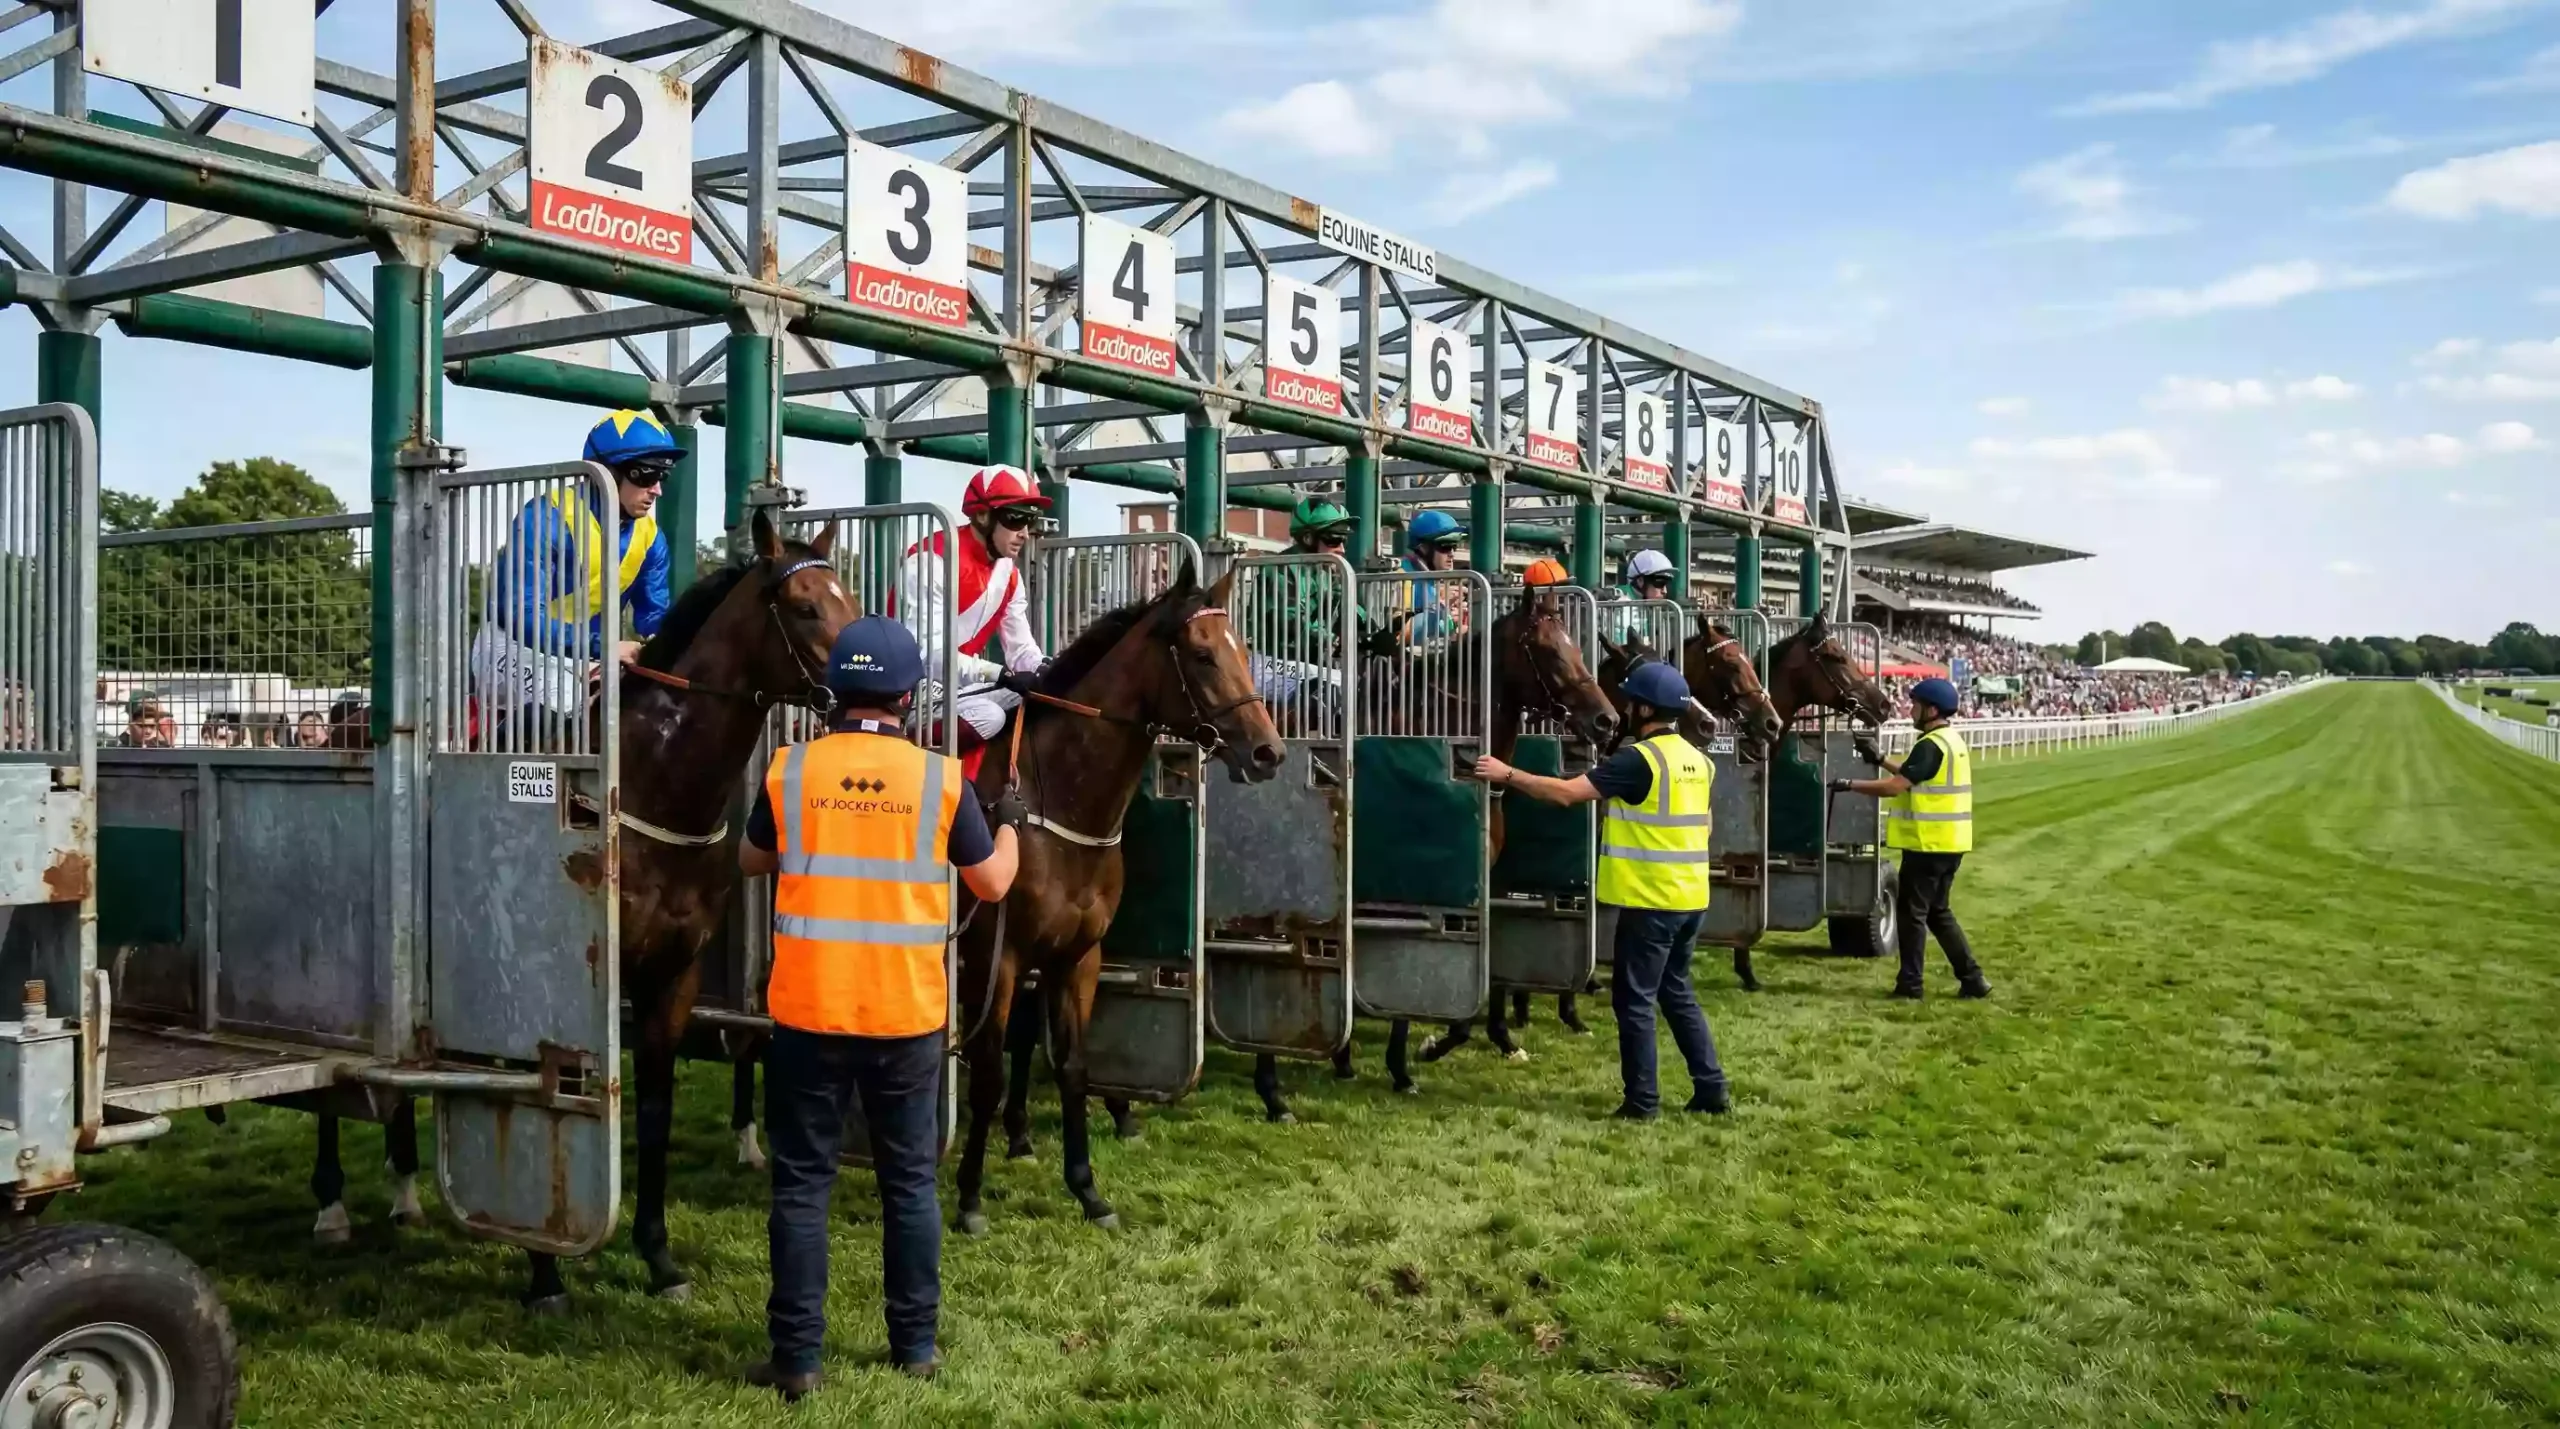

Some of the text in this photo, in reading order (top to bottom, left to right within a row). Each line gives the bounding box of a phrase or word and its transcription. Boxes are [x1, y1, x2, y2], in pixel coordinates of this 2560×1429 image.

[584, 74, 644, 192] 2
[542, 194, 682, 256] Ladbrokes
[886, 170, 932, 265] 3
[1322, 216, 1433, 276] EQUINE STALLS
[856, 271, 960, 320] Ladbrokes
[1112, 241, 1149, 321] 4
[1089, 329, 1170, 370] Ladbrokes
[1290, 291, 1318, 366] 5
[1271, 373, 1337, 409] Ladbrokes
[1431, 337, 1452, 401] 6
[1413, 409, 1468, 440] Ladbrokes
[1545, 371, 1563, 431] 7
[1638, 401, 1654, 456] 8
[1717, 427, 1731, 477] 9
[1778, 447, 1800, 497] 10
[511, 766, 554, 780] EQUINE
[511, 783, 554, 798] STALLS
[810, 797, 913, 815] UK JOCKEY CLUB
